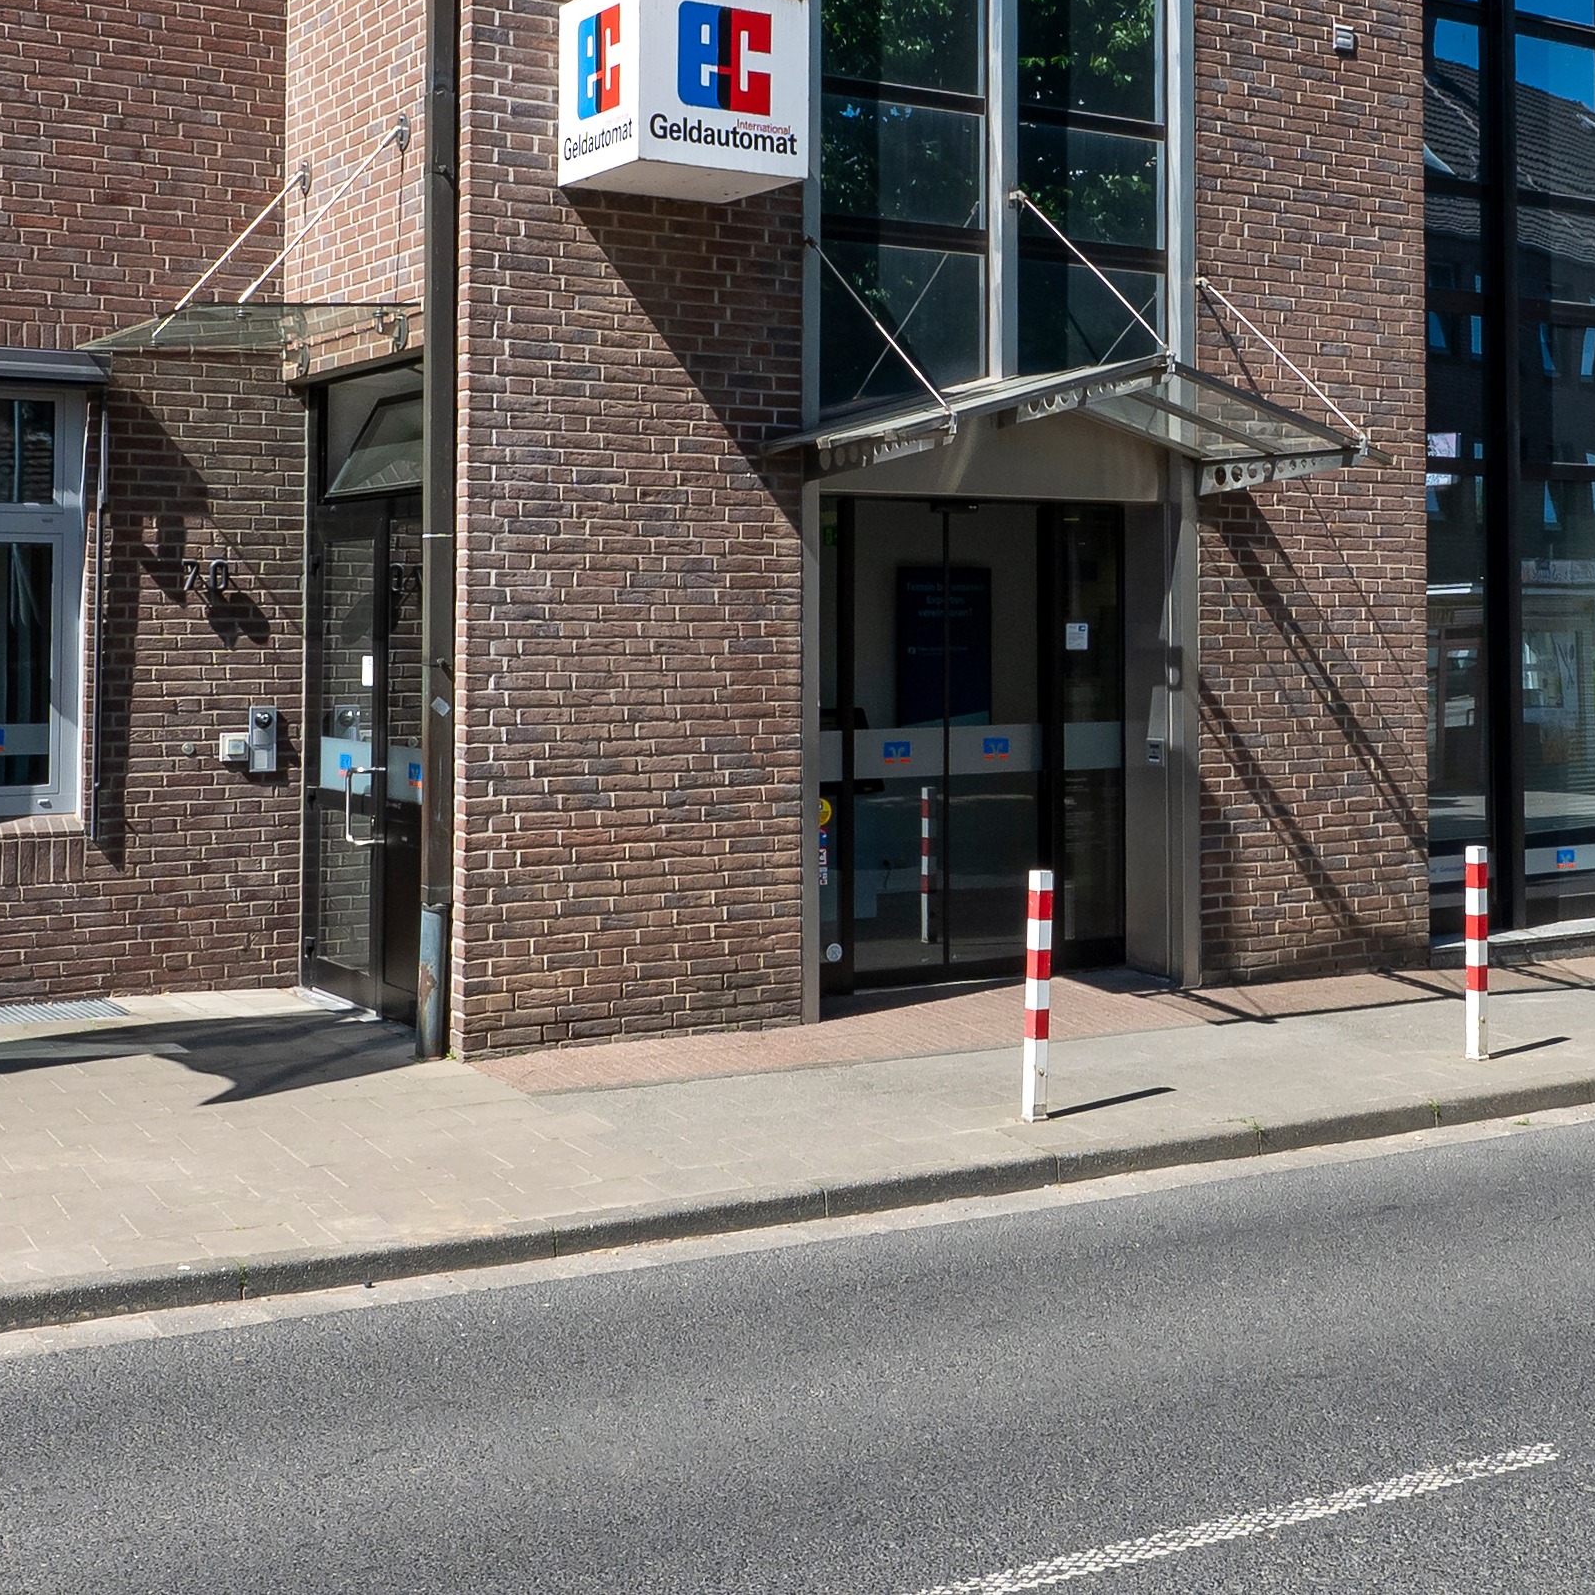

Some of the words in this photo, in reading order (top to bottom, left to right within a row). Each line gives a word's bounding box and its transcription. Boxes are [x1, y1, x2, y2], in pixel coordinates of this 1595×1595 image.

[564, 118, 632, 161] Geldautomat
[650, 113, 797, 155] Geldautomat
[736, 119, 791, 135] International
[182, 559, 229, 591] 70
